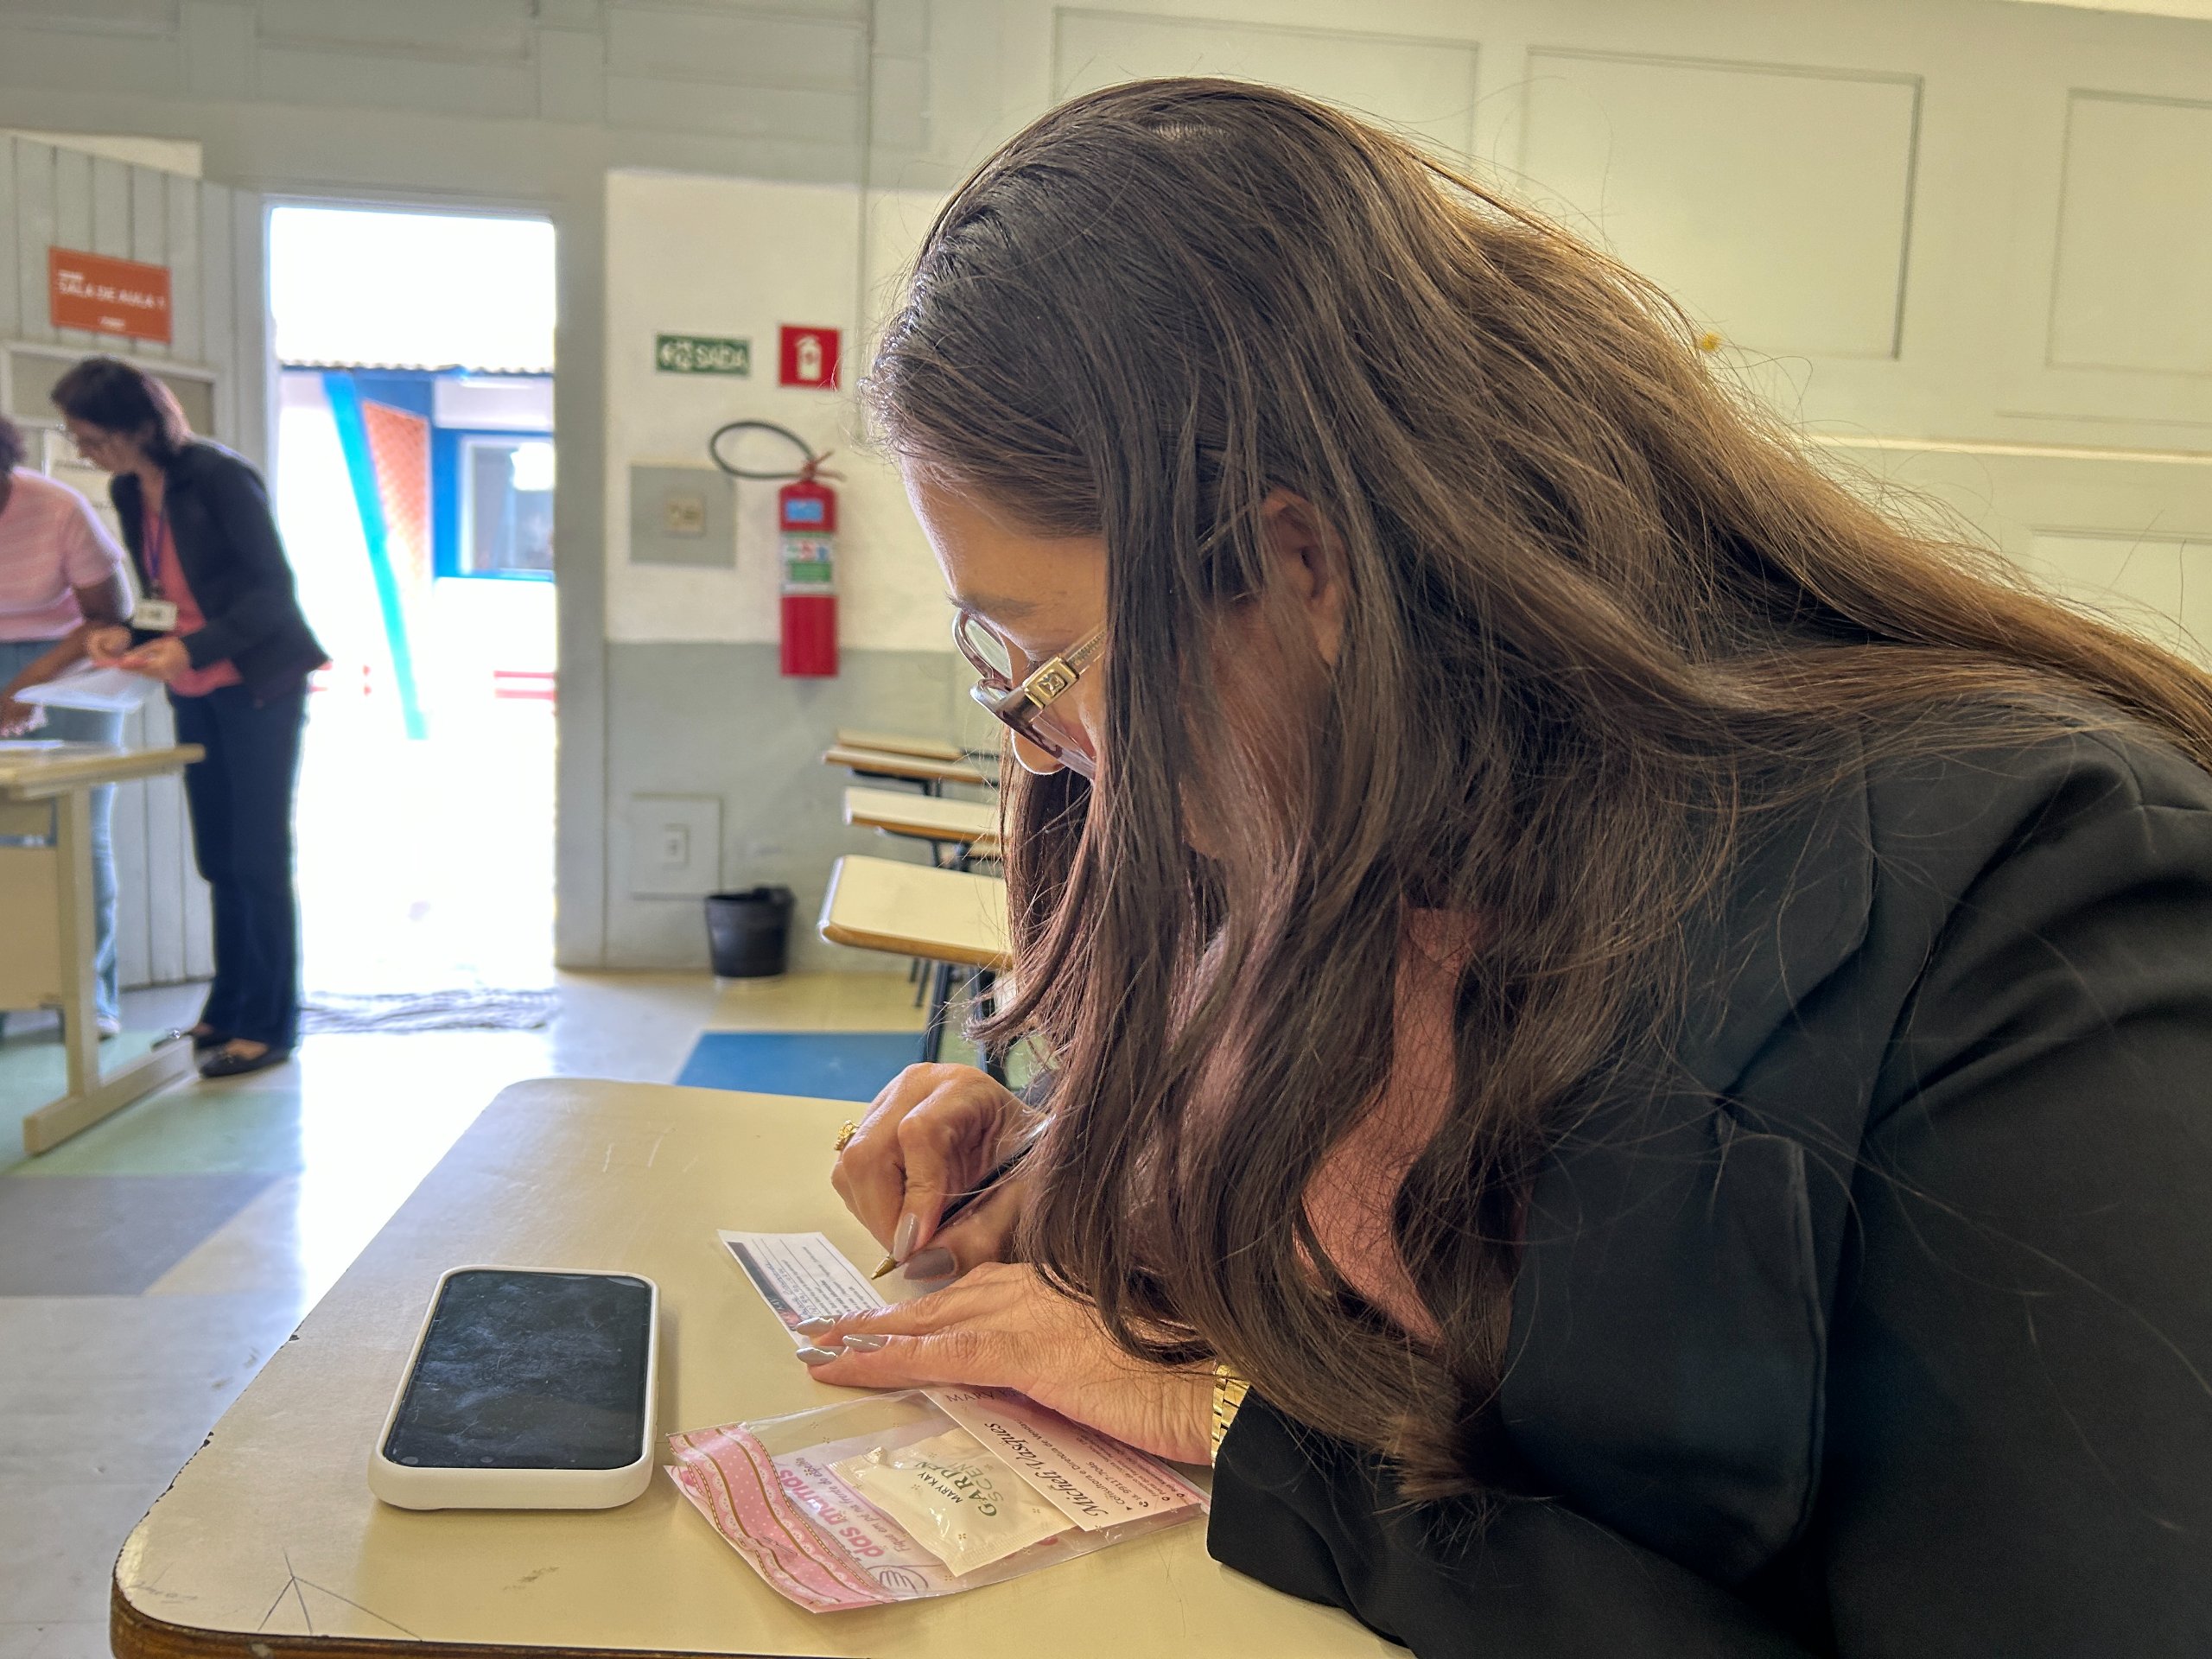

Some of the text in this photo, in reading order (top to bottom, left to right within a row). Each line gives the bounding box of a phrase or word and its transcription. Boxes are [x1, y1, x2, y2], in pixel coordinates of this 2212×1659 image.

[57, 280, 94, 298] SALA
[97, 285, 116, 301] DE
[118, 288, 156, 309] AULA
[984, 1422, 1045, 1470] Vasques
[817, 1478, 832, 1486] do
[829, 1485, 854, 1504] frente
[915, 1461, 997, 1516] GARDEN
[918, 1471, 963, 1503] MARY KAY
[1035, 1471, 1109, 1516] Micheli
[1085, 1474, 1126, 1504] Consultora
[779, 1469, 885, 1558] das mamas
[857, 1515, 880, 1525] pé
[872, 1523, 887, 1534] em
[884, 1534, 912, 1553] Fique
